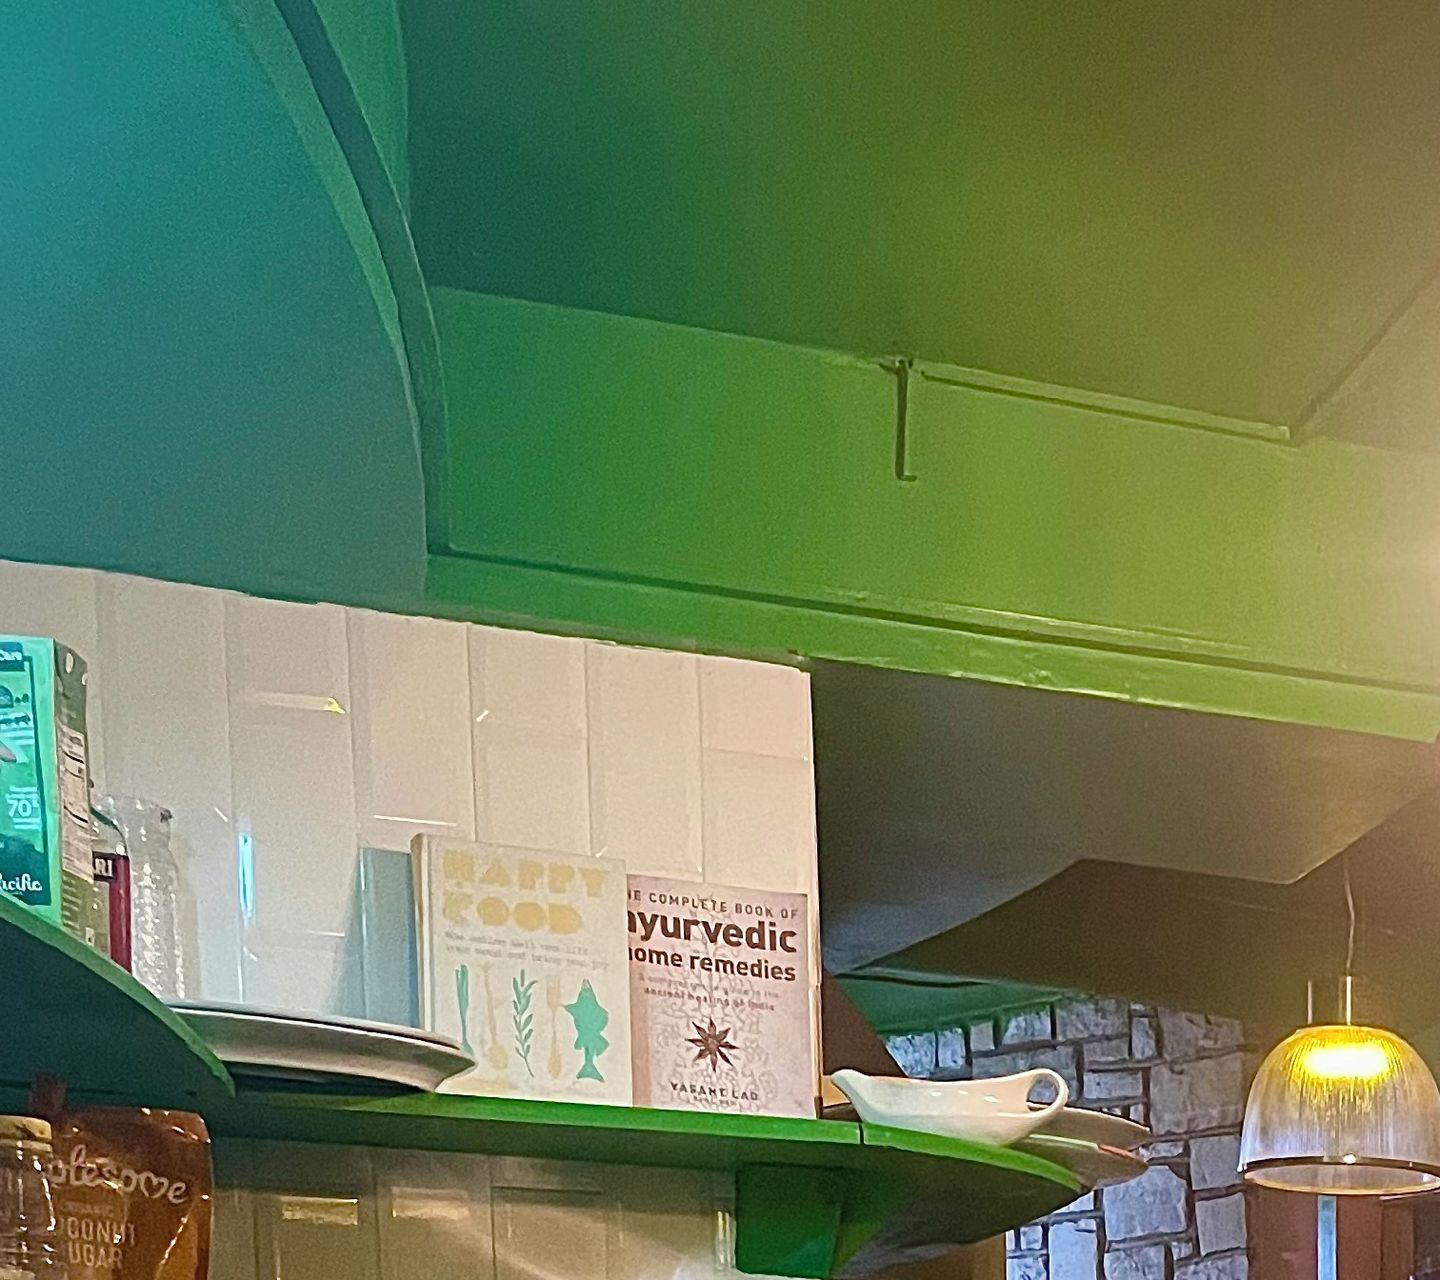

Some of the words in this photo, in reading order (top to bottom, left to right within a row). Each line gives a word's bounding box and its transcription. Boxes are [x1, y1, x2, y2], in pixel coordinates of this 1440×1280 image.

[442, 849, 610, 898] HAPPY
[442, 890, 583, 935] FOOD
[649, 891, 728, 913] COMPLETE
[735, 903, 773, 918] BOOK
[780, 908, 799, 920] OF
[690, 954, 797, 982] remedies
[67, 1241, 123, 1268] UGAR
